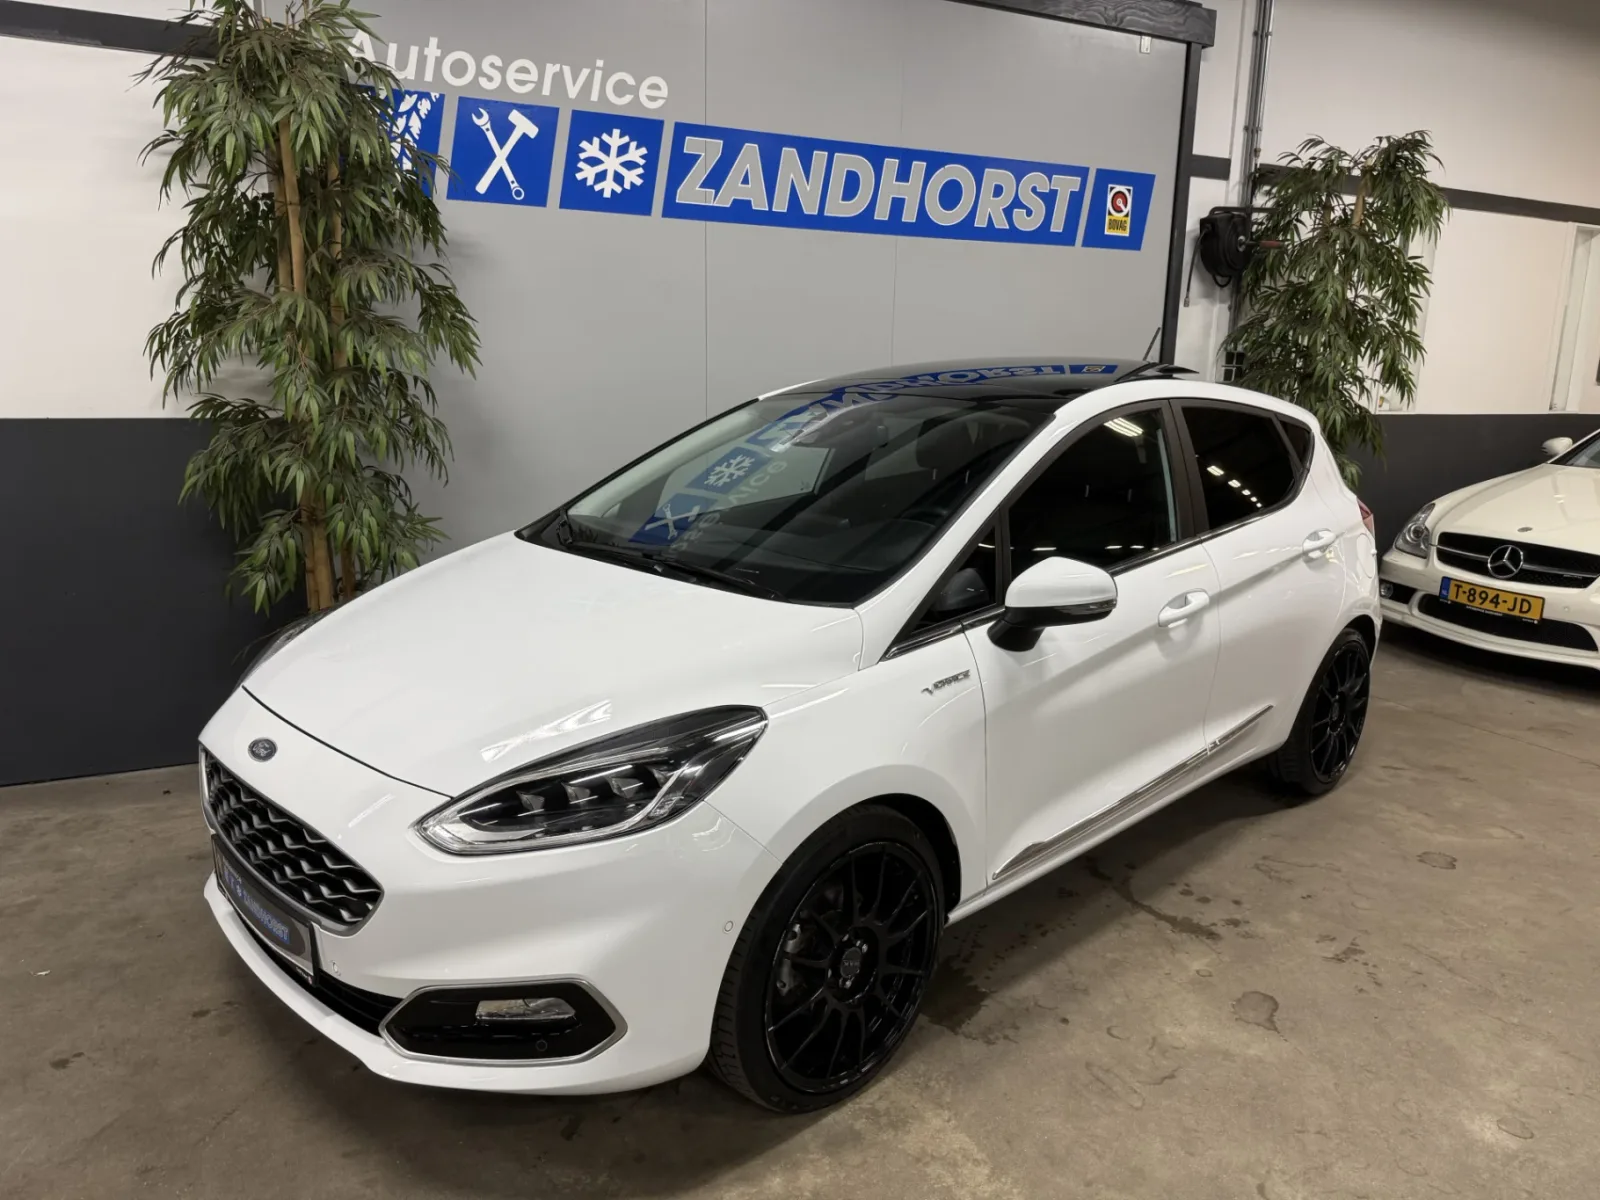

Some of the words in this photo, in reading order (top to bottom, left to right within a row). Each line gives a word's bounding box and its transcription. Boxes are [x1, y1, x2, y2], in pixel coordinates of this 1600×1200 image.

[345, 29, 669, 109] Autoservice
[676, 136, 1081, 233] ZANDHORST
[1108, 218, 1128, 231] BOVAG
[1453, 583, 1532, 615] T-894-JD
